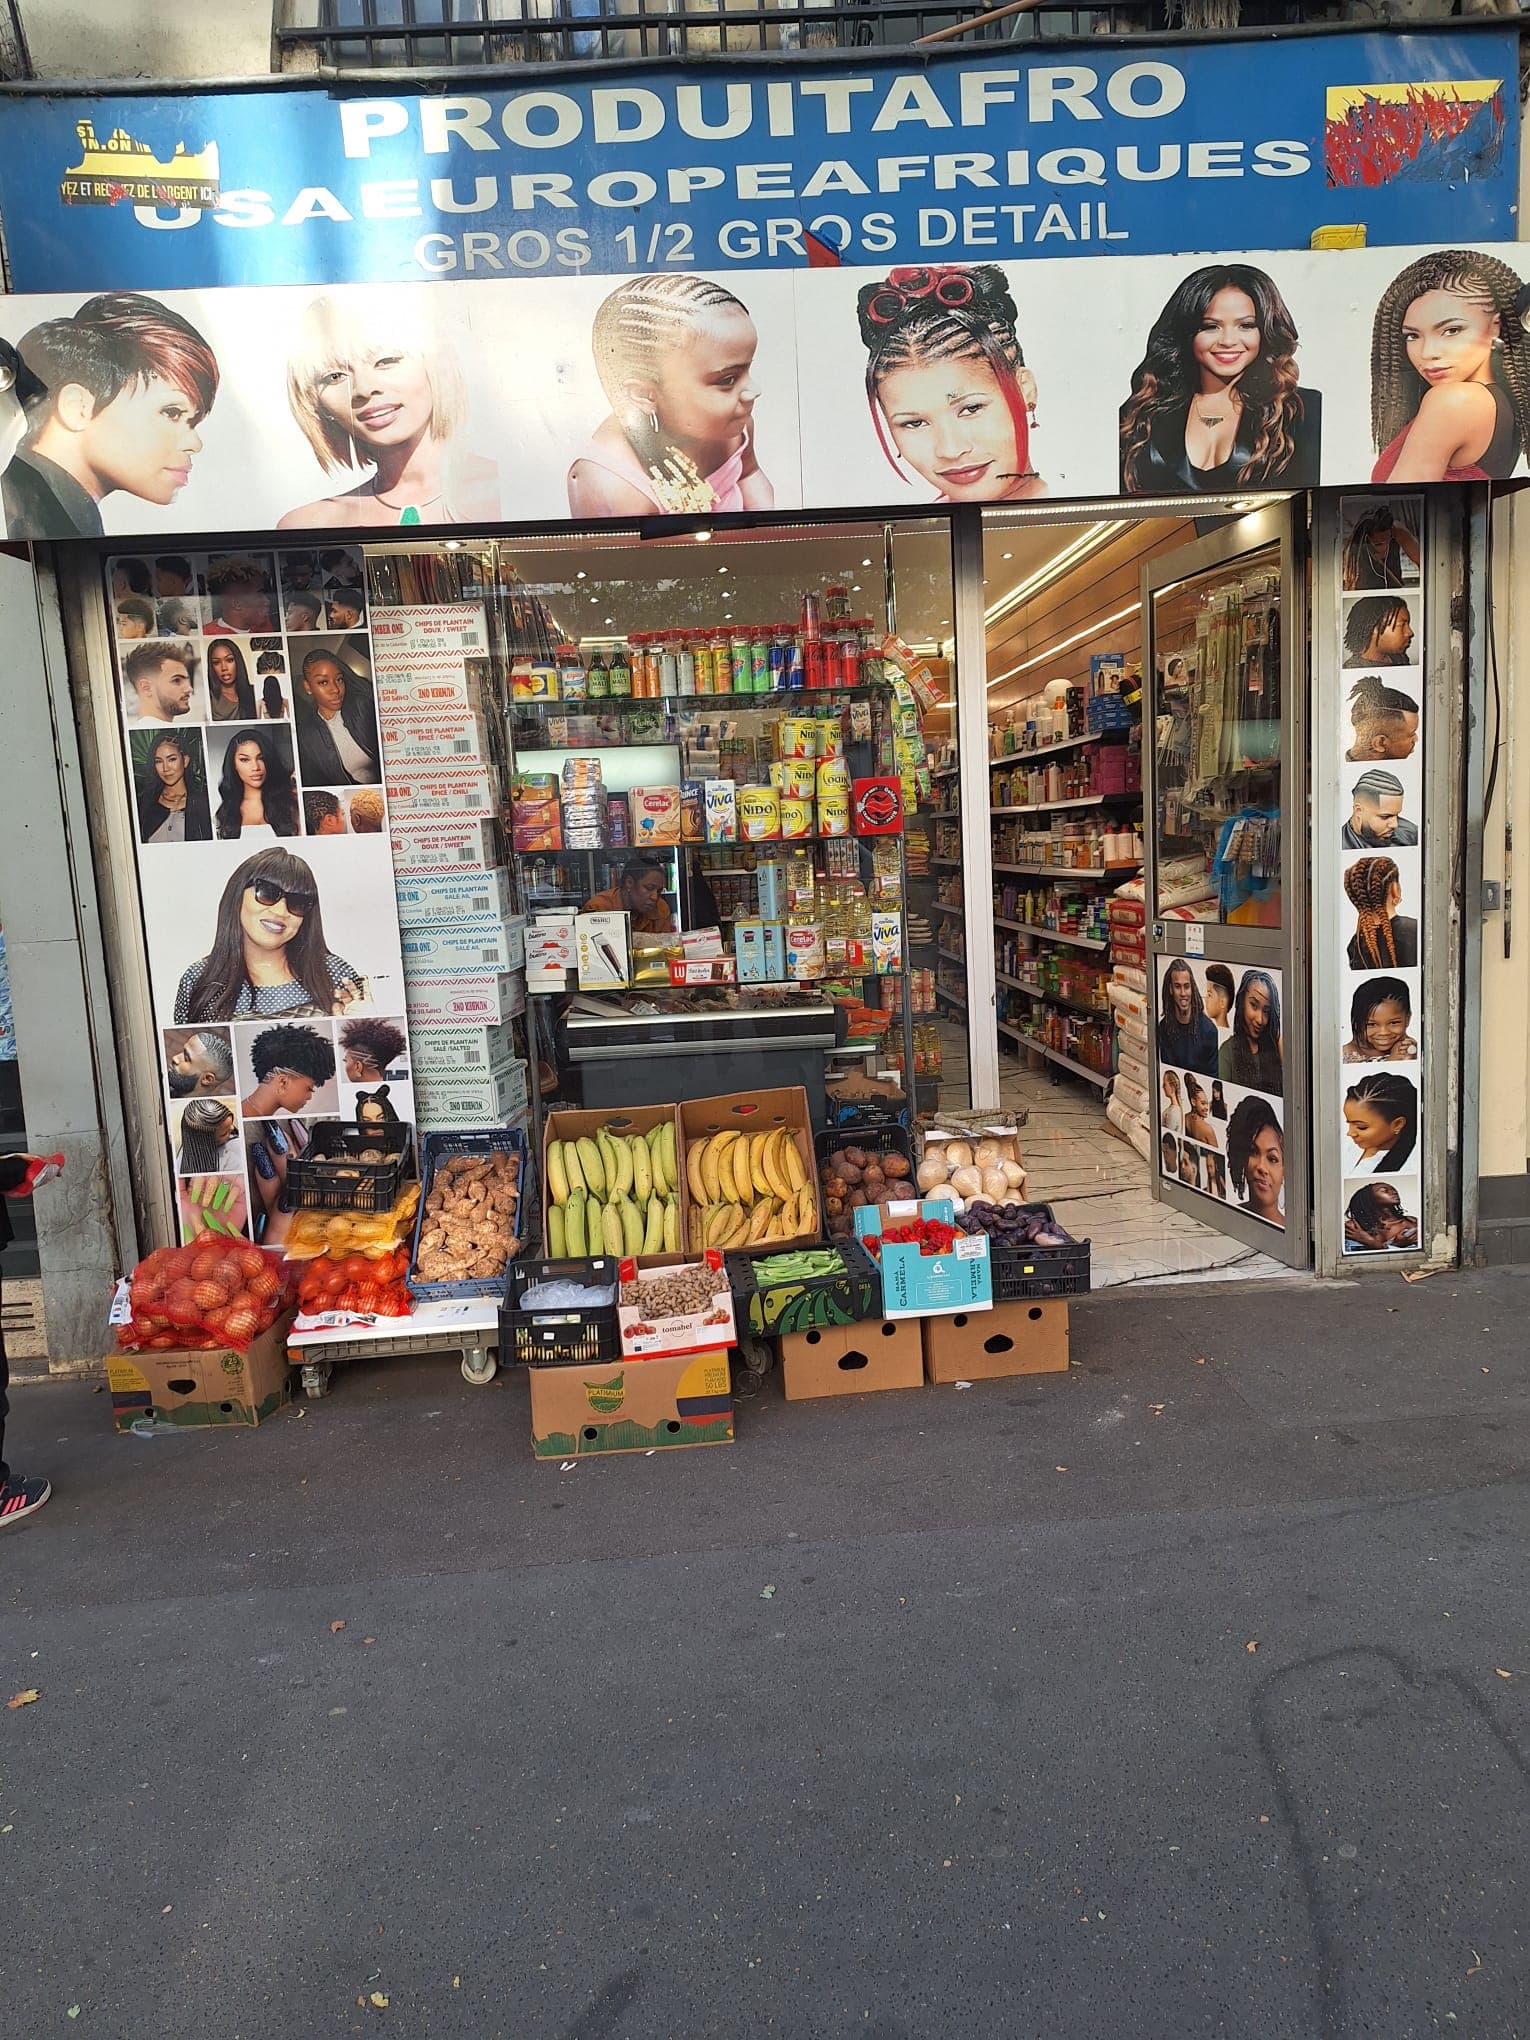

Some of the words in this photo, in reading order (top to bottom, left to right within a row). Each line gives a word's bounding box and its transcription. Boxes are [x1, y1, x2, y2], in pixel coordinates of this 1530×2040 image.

[81, 182, 91, 196] ET
[137, 186, 149, 198] DE
[200, 188, 213, 201] ICI
[413, 226, 592, 274] GROS
[614, 222, 695, 264] 1/2
[718, 211, 898, 260] GROS
[918, 200, 1129, 248] DETAIL
[417, 688, 430, 699] ONE
[431, 687, 455, 698] NUMBER
[399, 786, 412, 797] ONE
[644, 799, 671, 807] Cerelac
[743, 804, 773, 816] NIDO
[407, 891, 419, 901] ONE
[431, 887, 448, 895] CHIPS
[791, 935, 814, 944] Cerelac
[420, 942, 431, 952] ONE
[674, 966, 685, 979] LU
[453, 1002, 465, 1011] ONE
[465, 1001, 487, 1011] NUMBER
[449, 1102, 461, 1111] ONE
[462, 1101, 483, 1111] NUMBER
[900, 1256, 908, 1307] CARMELA
